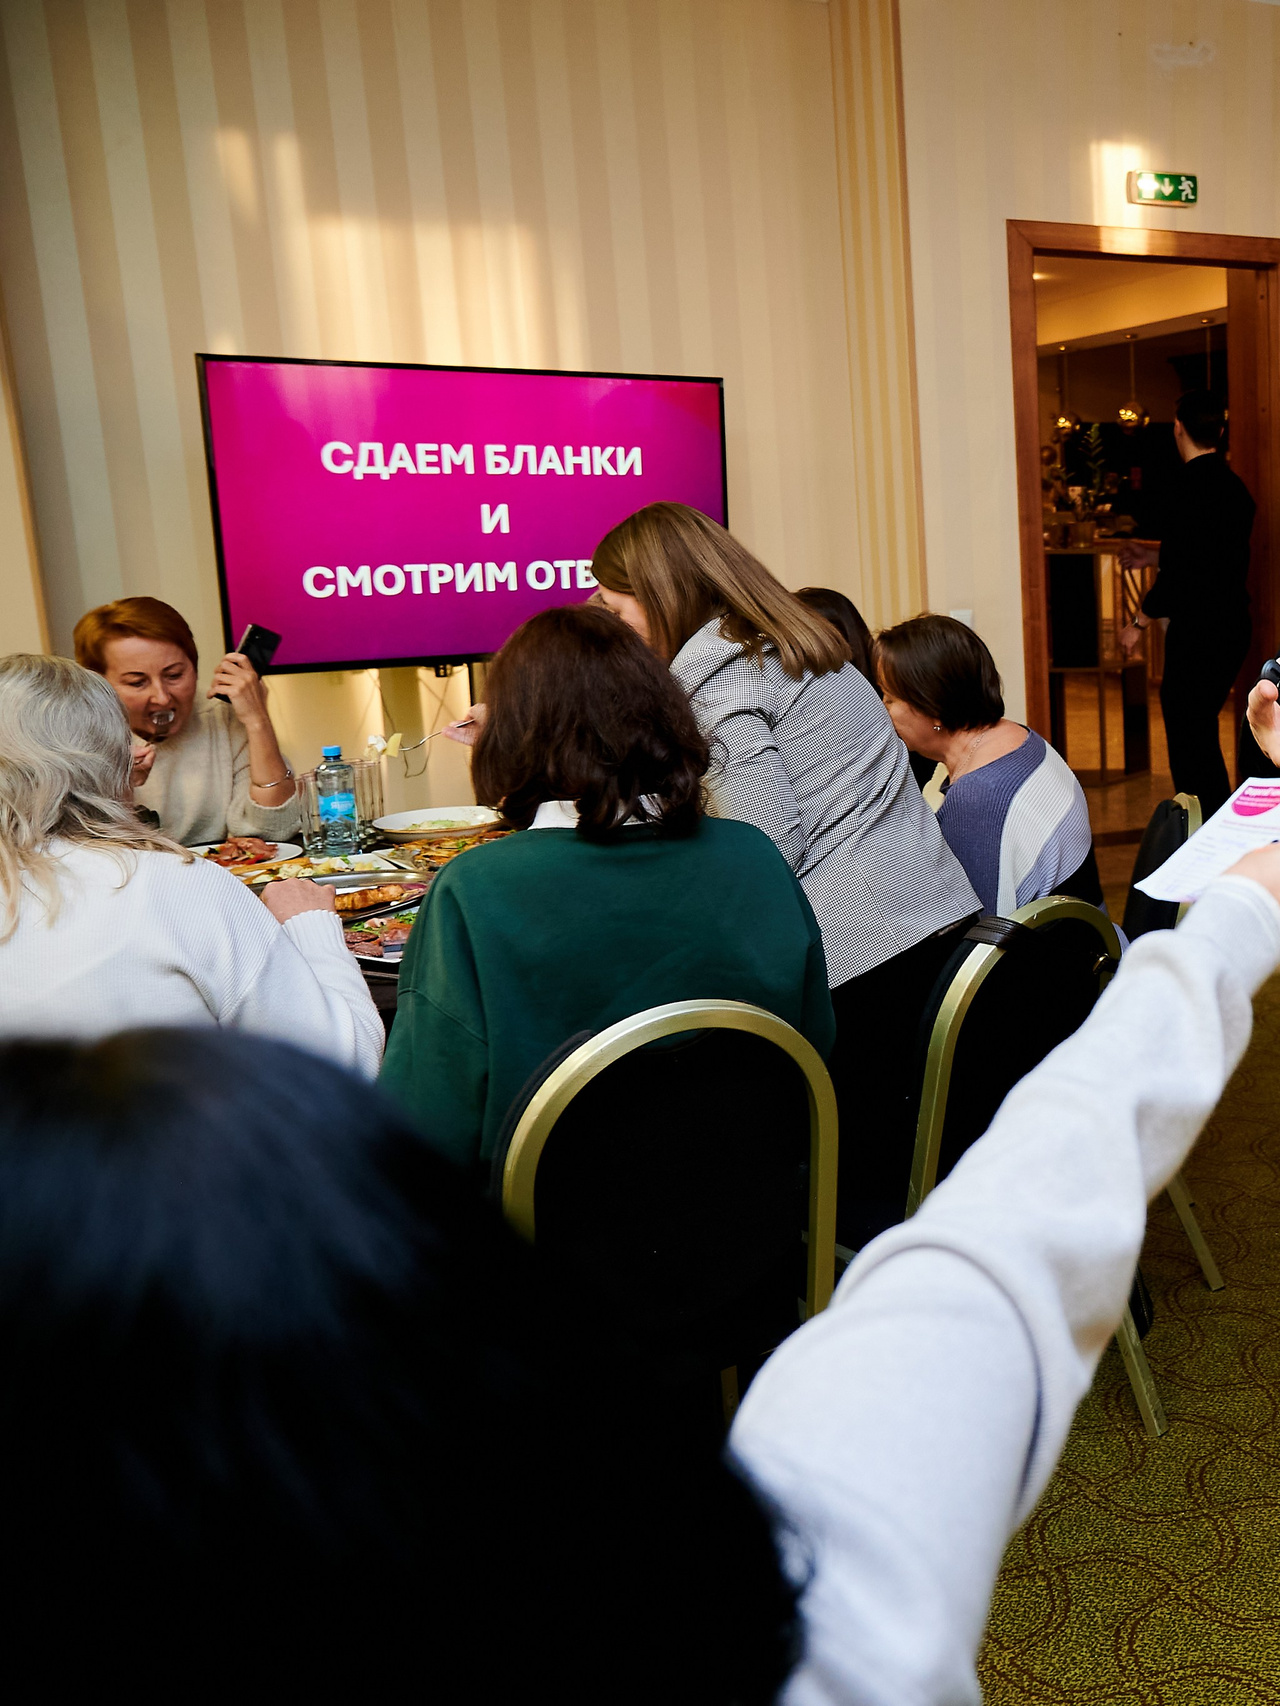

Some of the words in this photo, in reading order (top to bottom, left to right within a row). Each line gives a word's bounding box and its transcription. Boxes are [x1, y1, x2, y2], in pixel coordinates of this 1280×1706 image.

[320, 441, 475, 480] СДАЕМ
[484, 444, 643, 476] БЛАНКИ
[480, 503, 510, 533] И
[302, 561, 518, 598] СМОТРИМ
